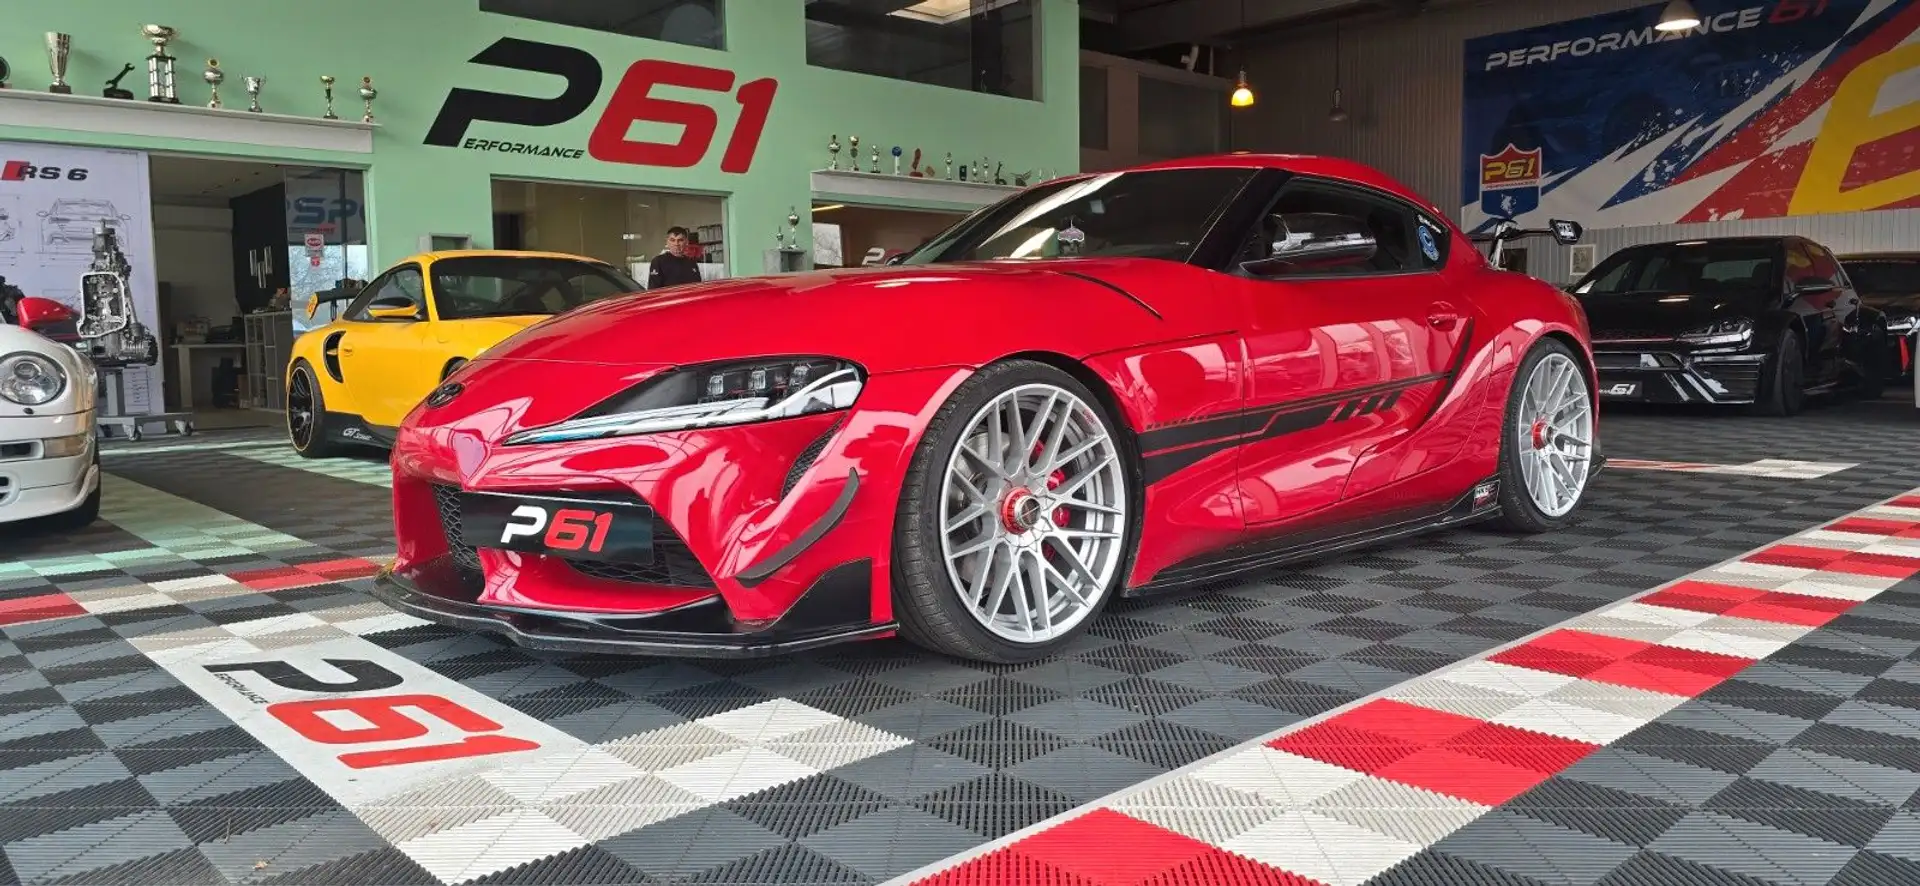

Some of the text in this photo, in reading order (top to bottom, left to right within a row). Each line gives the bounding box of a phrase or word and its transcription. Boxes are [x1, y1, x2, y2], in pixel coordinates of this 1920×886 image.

[16, 165, 89, 181] RS 6
[500, 505, 613, 552] P61
